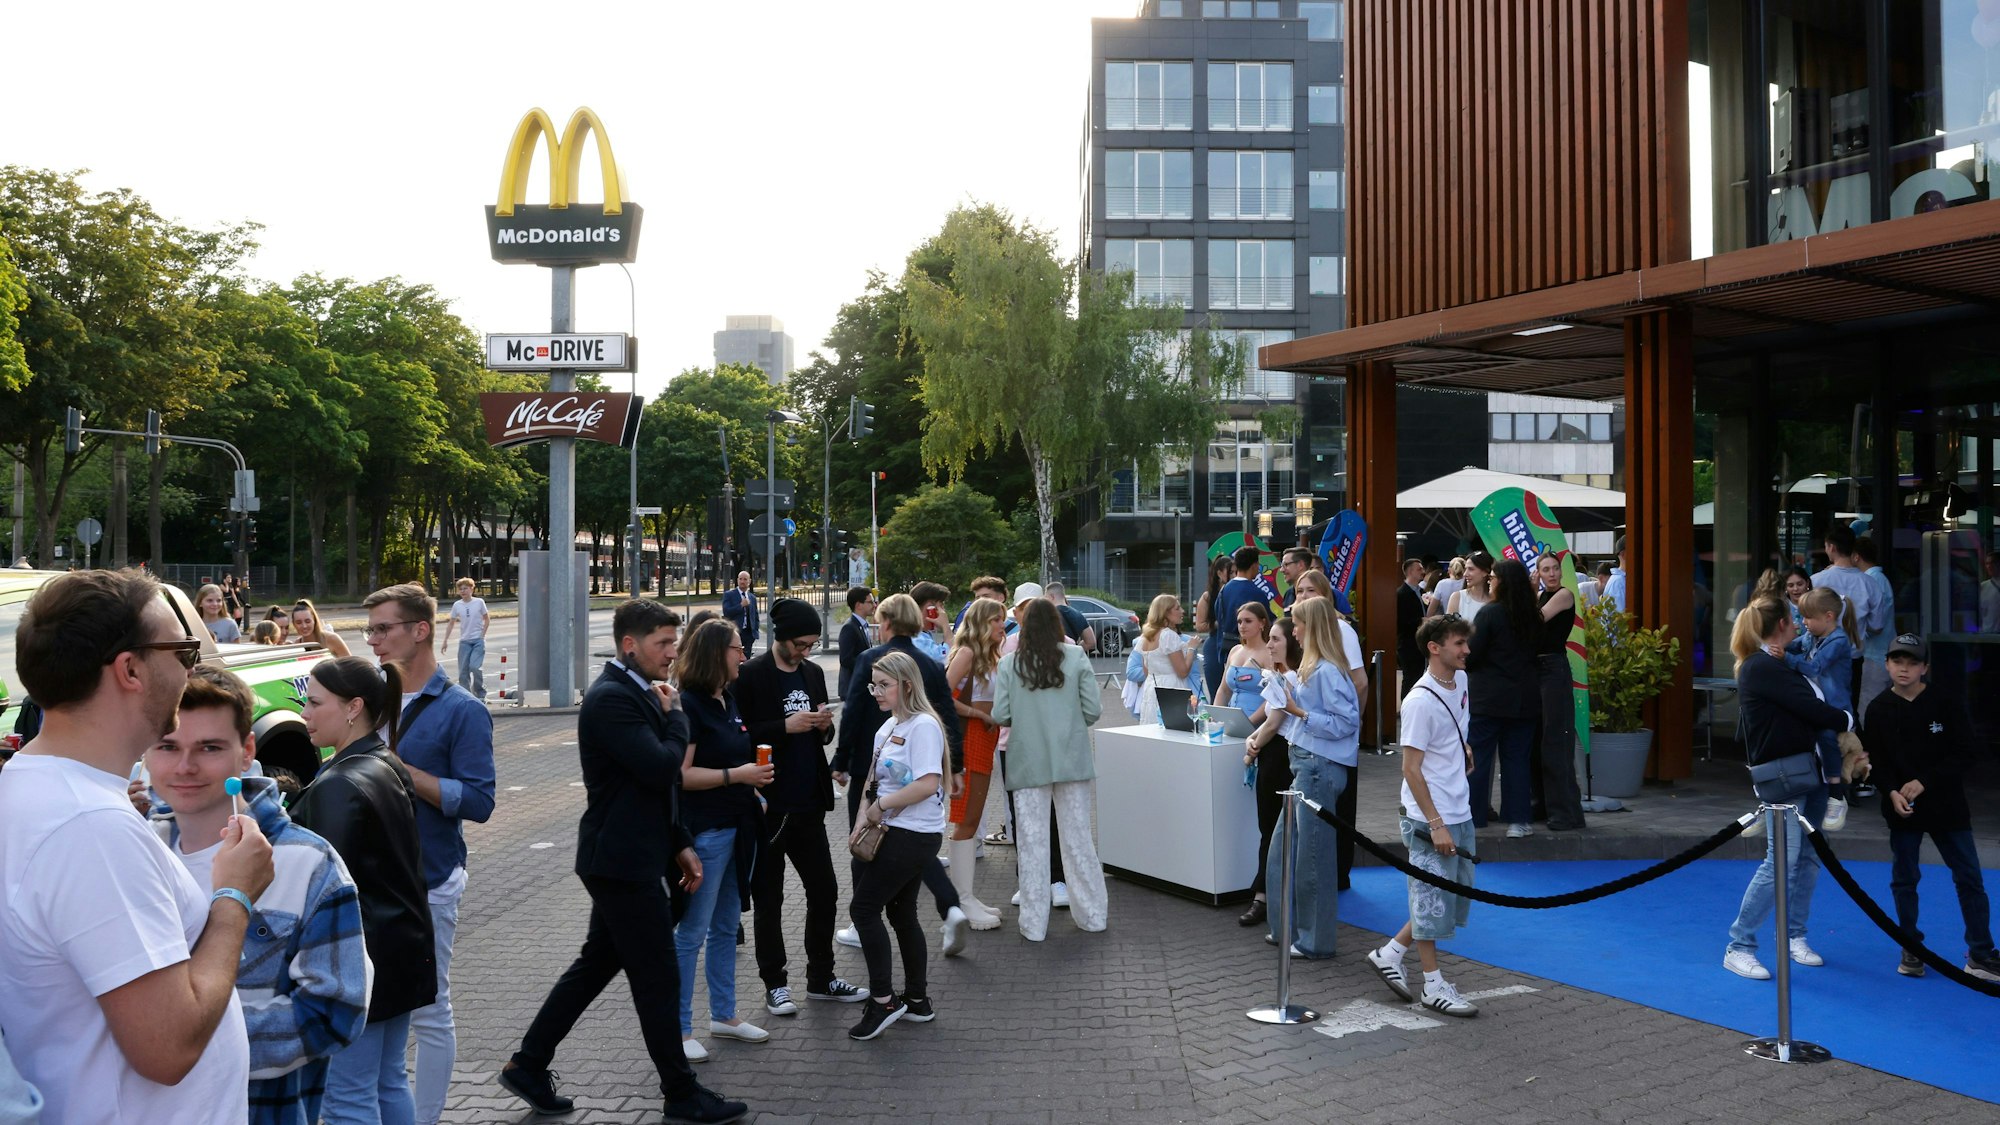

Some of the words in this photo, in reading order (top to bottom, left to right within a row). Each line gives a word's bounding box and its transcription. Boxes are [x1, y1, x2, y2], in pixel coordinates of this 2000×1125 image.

[497, 226, 621, 244] McDonald's
[506, 339, 535, 361] Mc
[550, 339, 604, 362] DRIVE
[505, 396, 606, 434] McCafé
